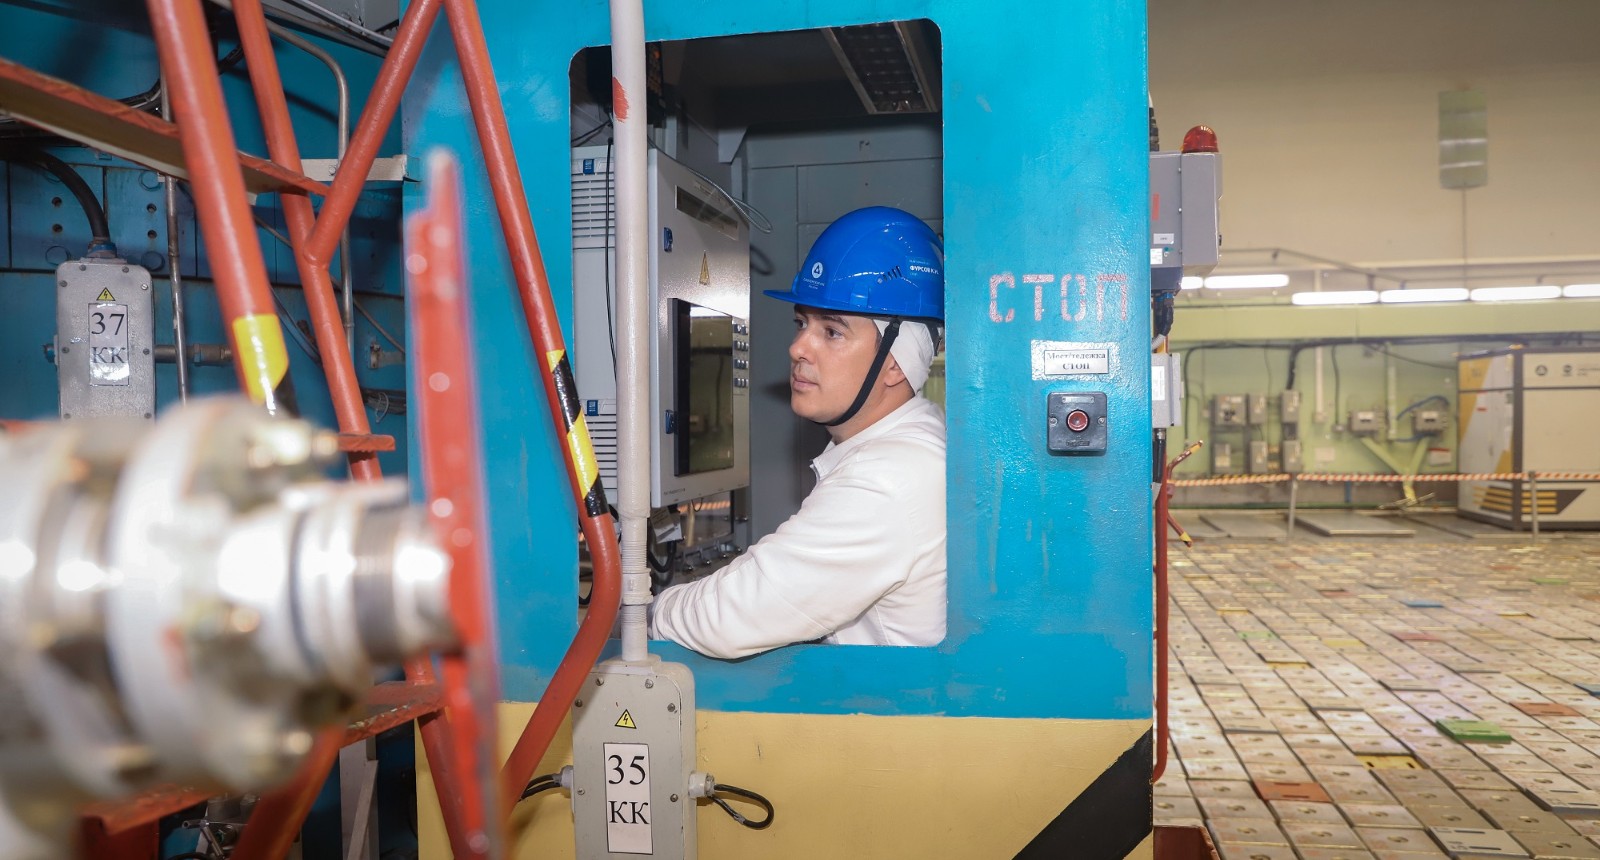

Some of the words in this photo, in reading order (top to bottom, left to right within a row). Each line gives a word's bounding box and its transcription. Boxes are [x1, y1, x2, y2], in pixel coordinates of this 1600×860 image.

[989, 273, 1127, 323] СТОП
[91, 312, 125, 336] 37
[91, 346, 127, 364] КК
[608, 754, 646, 786] 35
[608, 800, 650, 825] КК
